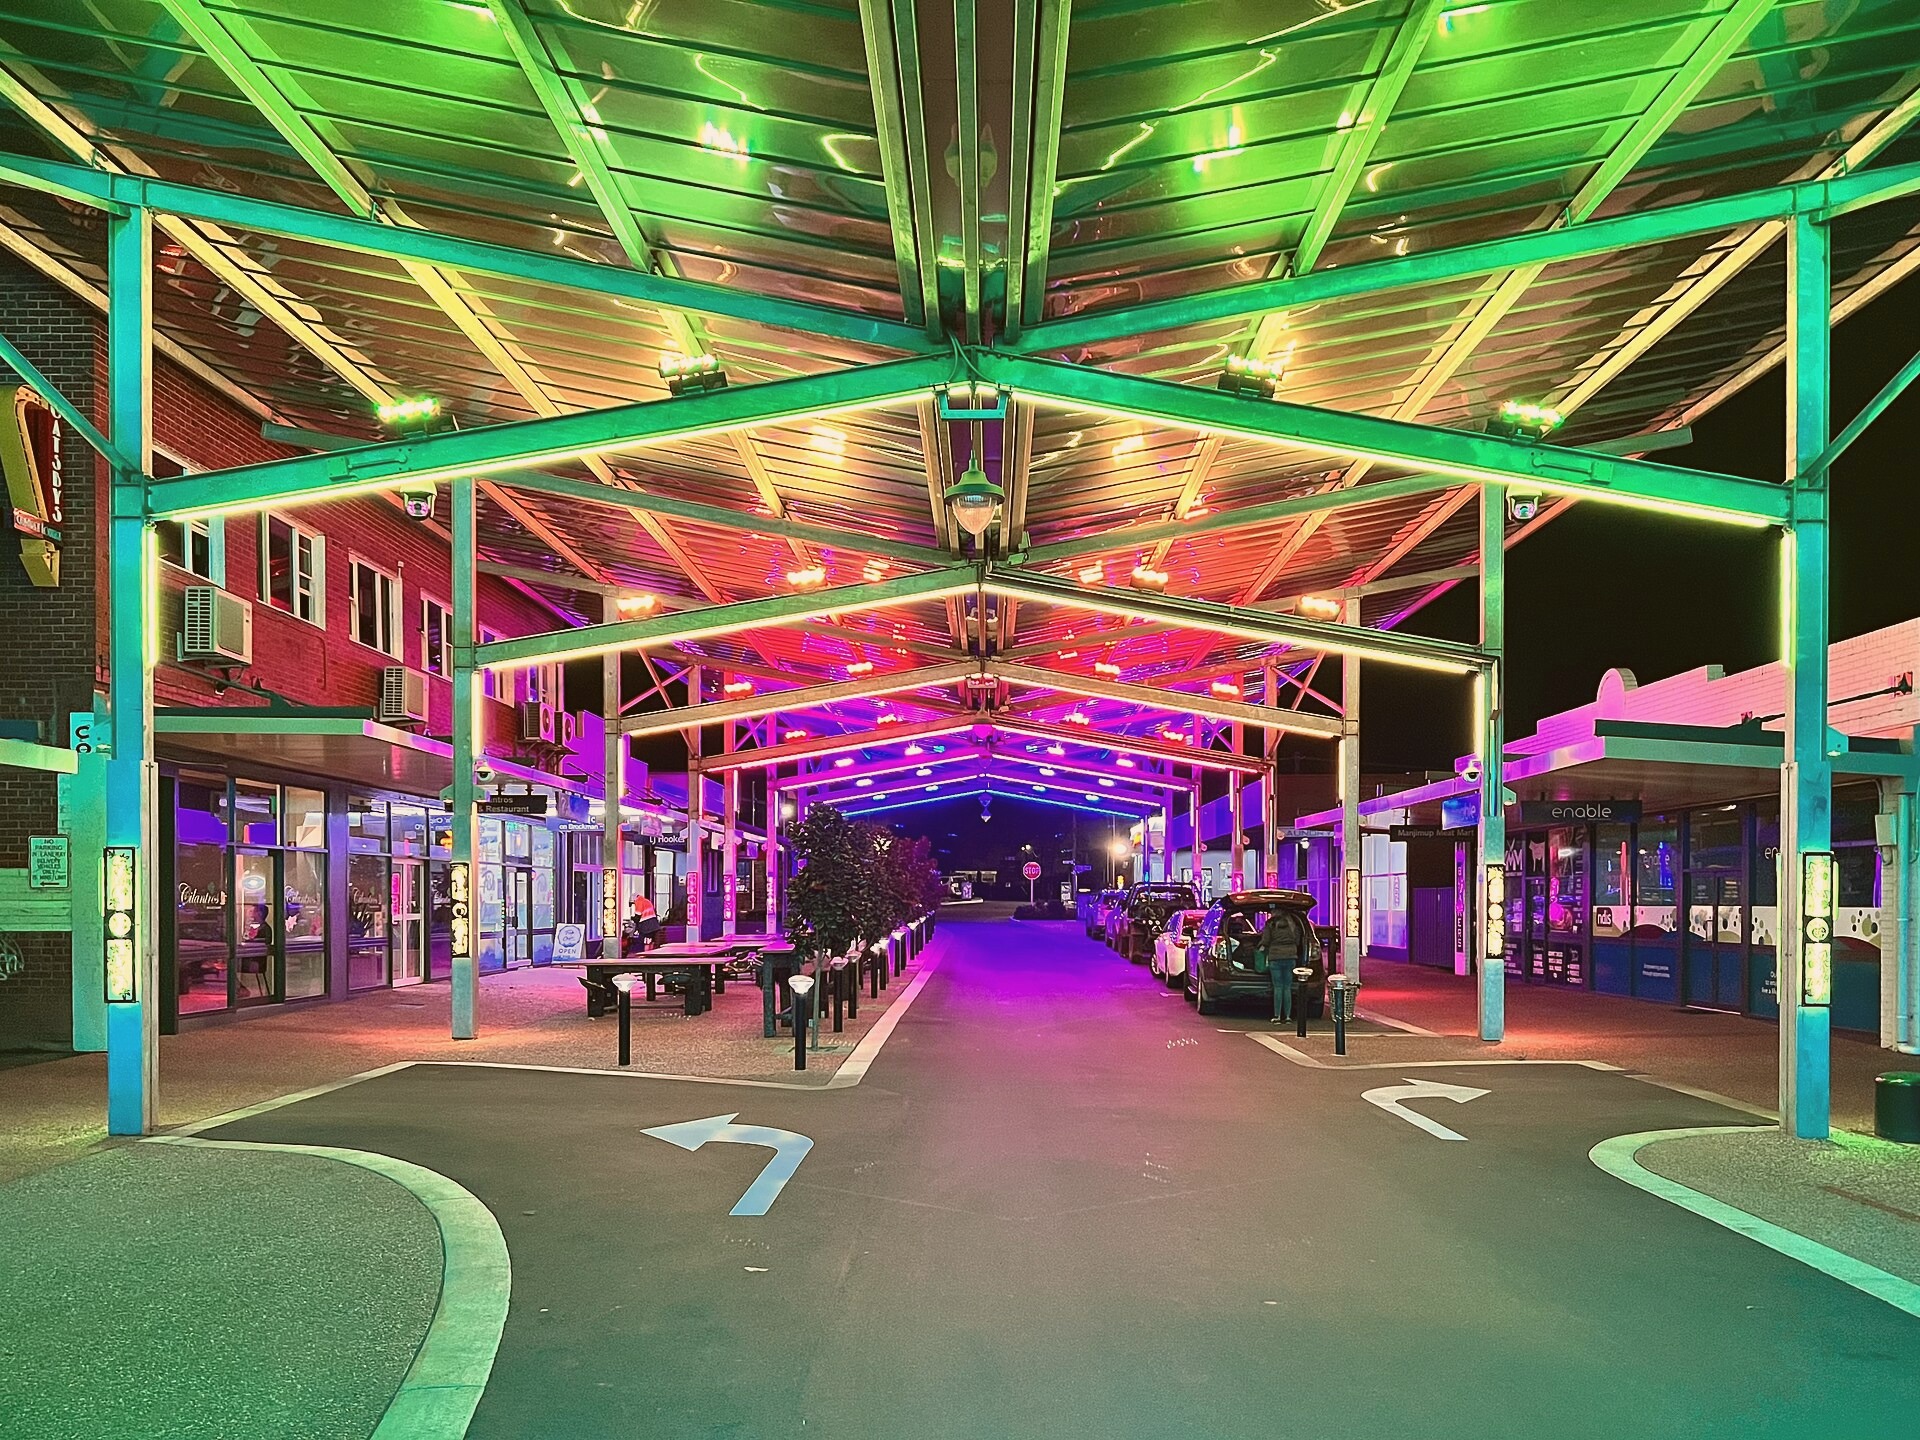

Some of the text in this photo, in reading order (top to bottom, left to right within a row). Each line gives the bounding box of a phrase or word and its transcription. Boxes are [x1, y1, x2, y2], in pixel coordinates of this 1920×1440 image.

[485, 805, 530, 813] Restaurant
[1551, 803, 1612, 818] enable
[1397, 829, 1474, 838] Manjimup Meat Mart
[1024, 866, 1040, 875] STOP
[178, 882, 220, 904] Cilantros
[1597, 909, 1612, 925] ndis
